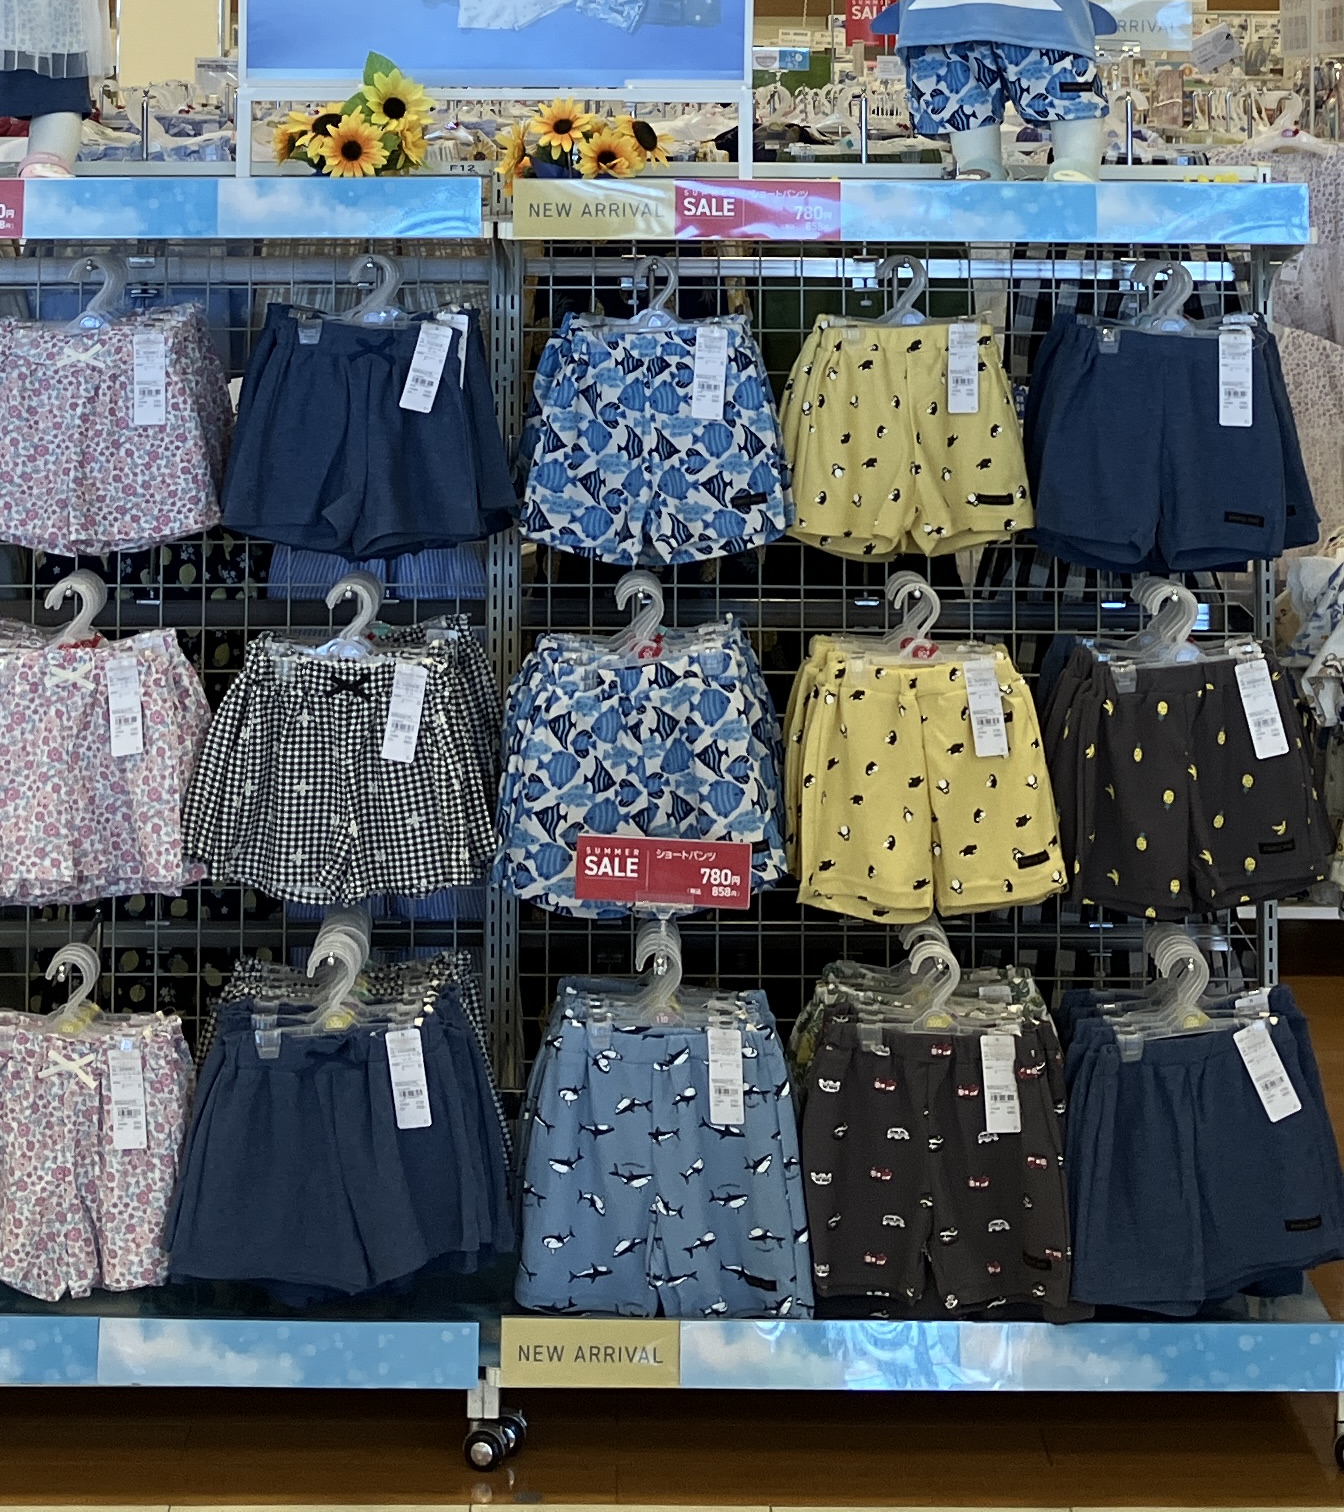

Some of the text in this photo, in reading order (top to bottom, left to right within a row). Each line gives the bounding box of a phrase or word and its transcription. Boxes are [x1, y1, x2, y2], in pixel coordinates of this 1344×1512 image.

[529, 202, 665, 219] NEW ARRIVAL
[683, 197, 735, 218] SALE
[793, 205, 833, 222] 780円
[586, 846, 640, 856] SUMMER
[656, 849, 717, 862] ショートパンツ
[584, 856, 639, 878] SALE
[700, 867, 741, 886] 780円
[518, 1345, 664, 1365] NEW ARRIVAL
